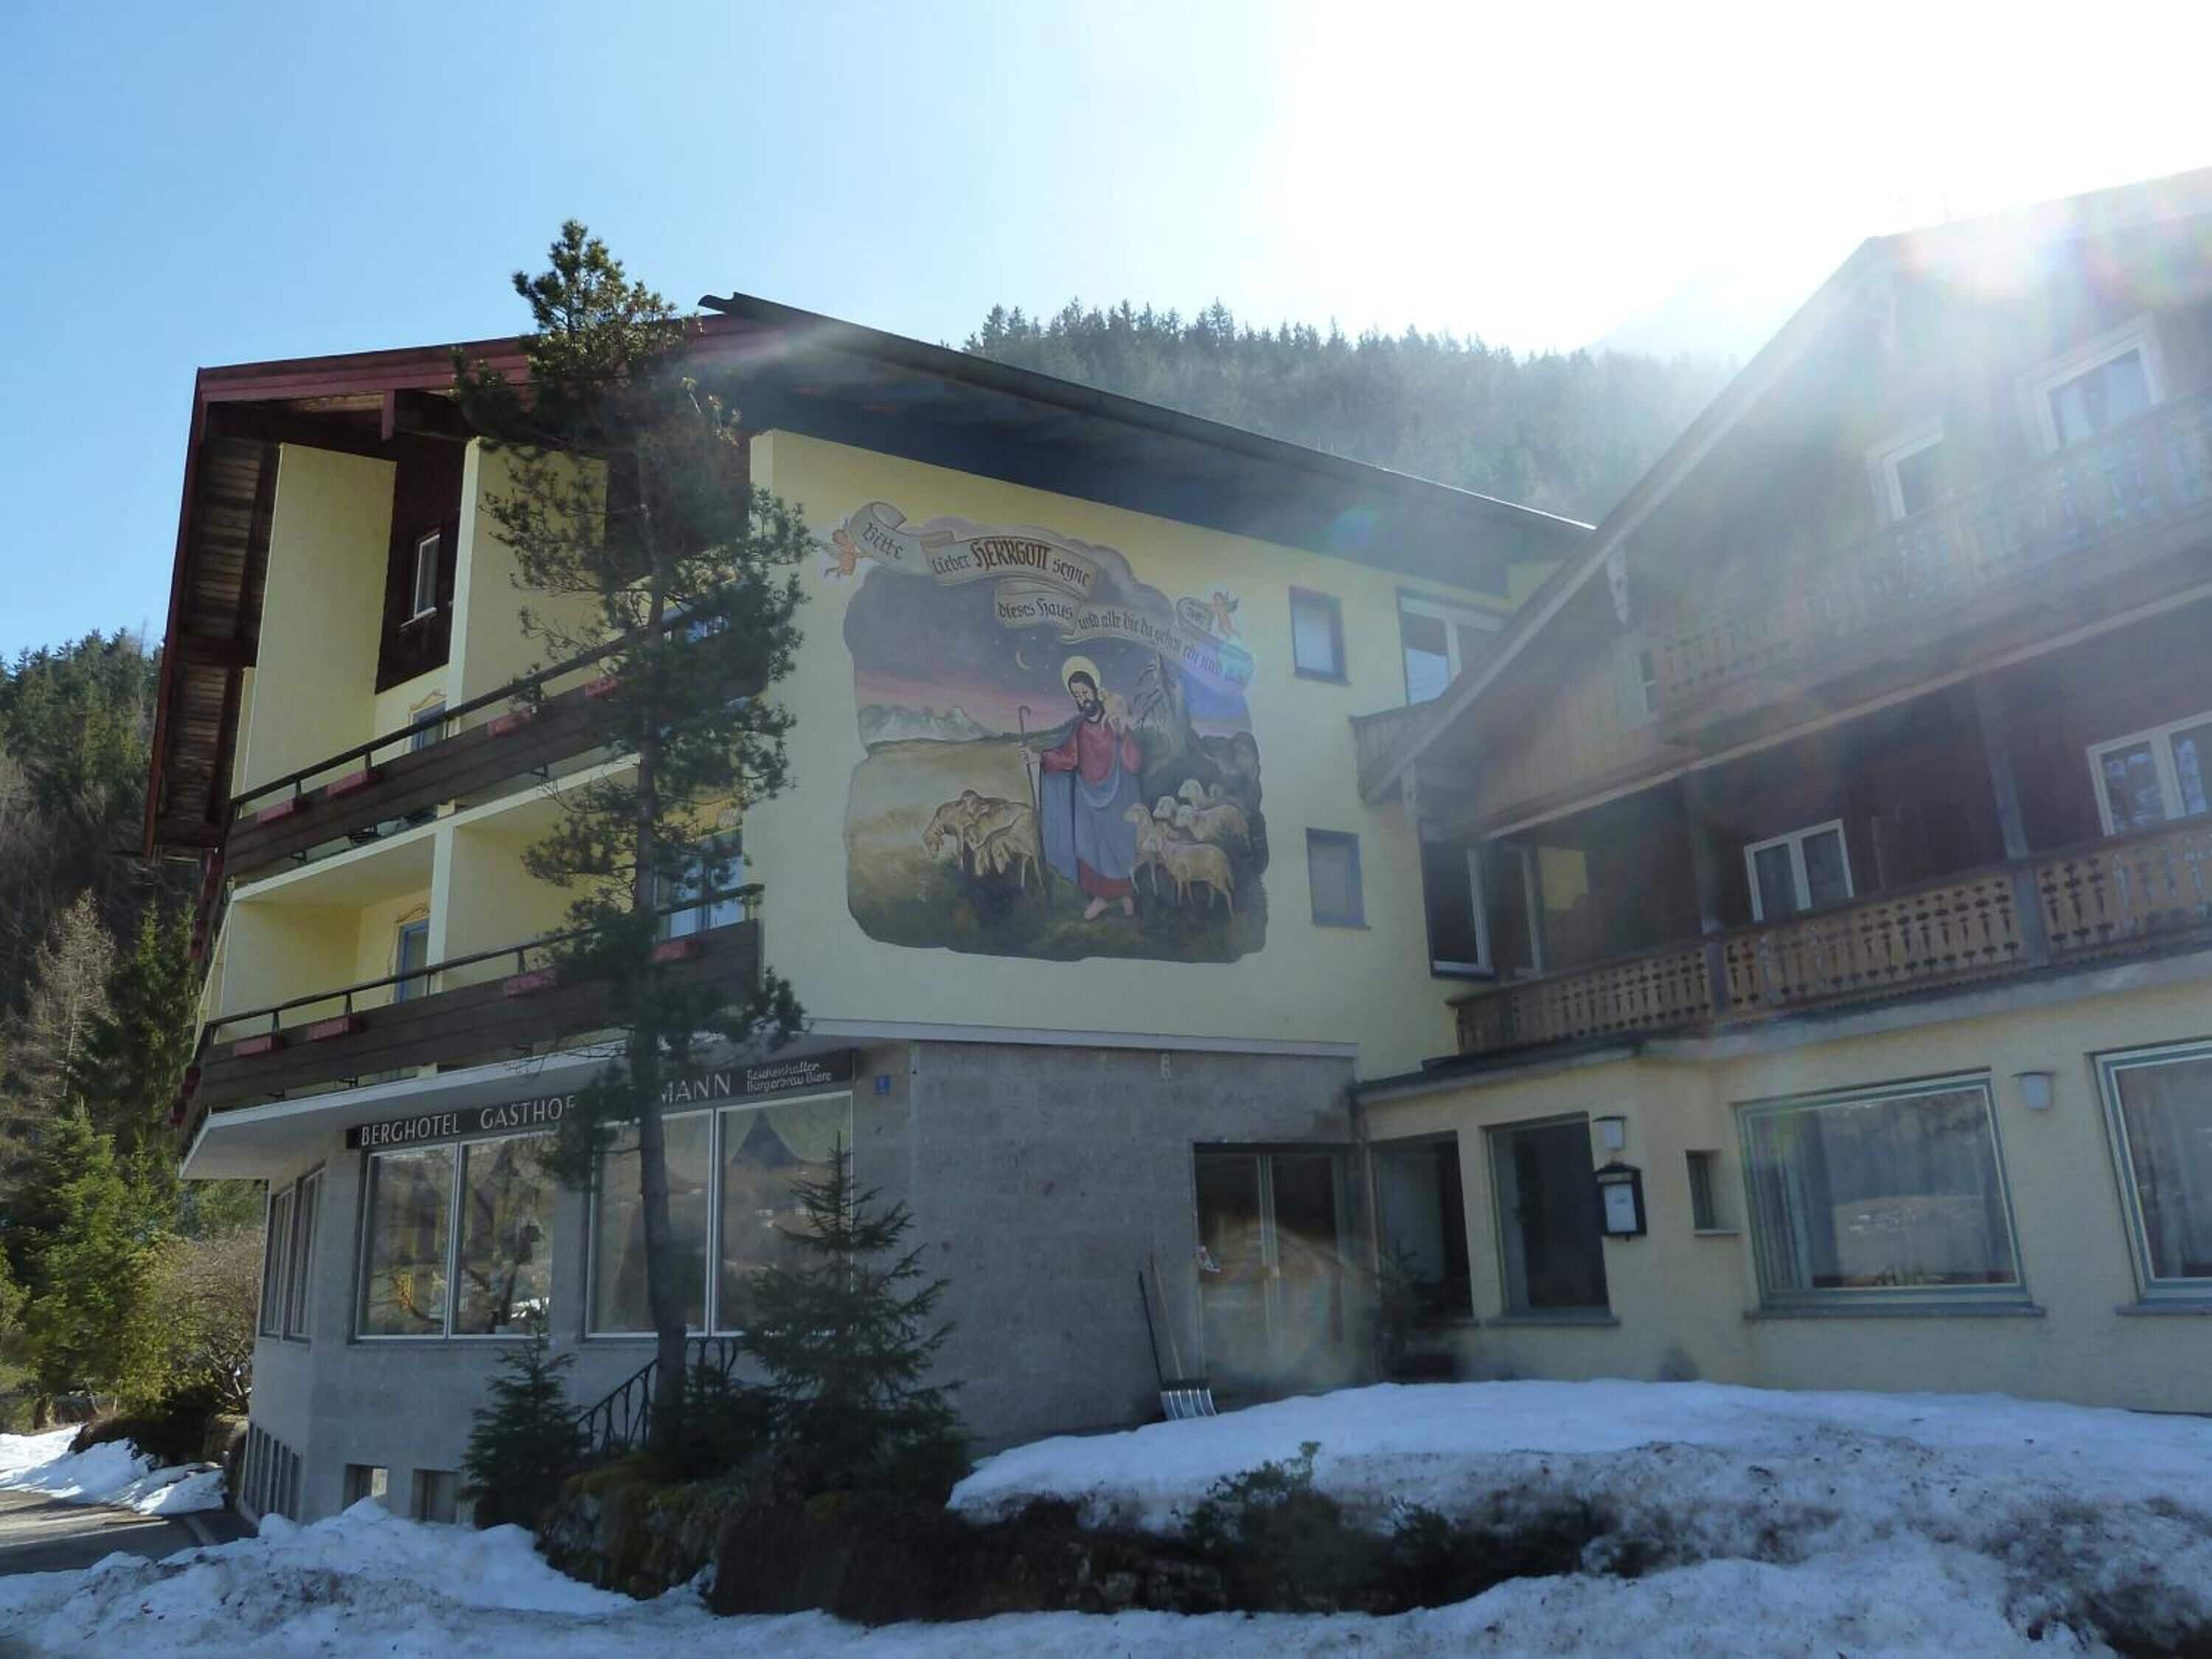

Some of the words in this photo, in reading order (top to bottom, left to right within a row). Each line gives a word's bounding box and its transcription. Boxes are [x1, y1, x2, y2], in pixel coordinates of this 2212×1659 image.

[862, 521, 903, 560] Bitte
[970, 538, 1051, 573] HERRGOTT
[1051, 558, 1090, 589] segne
[998, 601, 1036, 621] dieses
[1035, 597, 1074, 621] Haus
[360, 1112, 461, 1146] BERGHOTEL
[479, 1094, 577, 1130] GASTHOF
